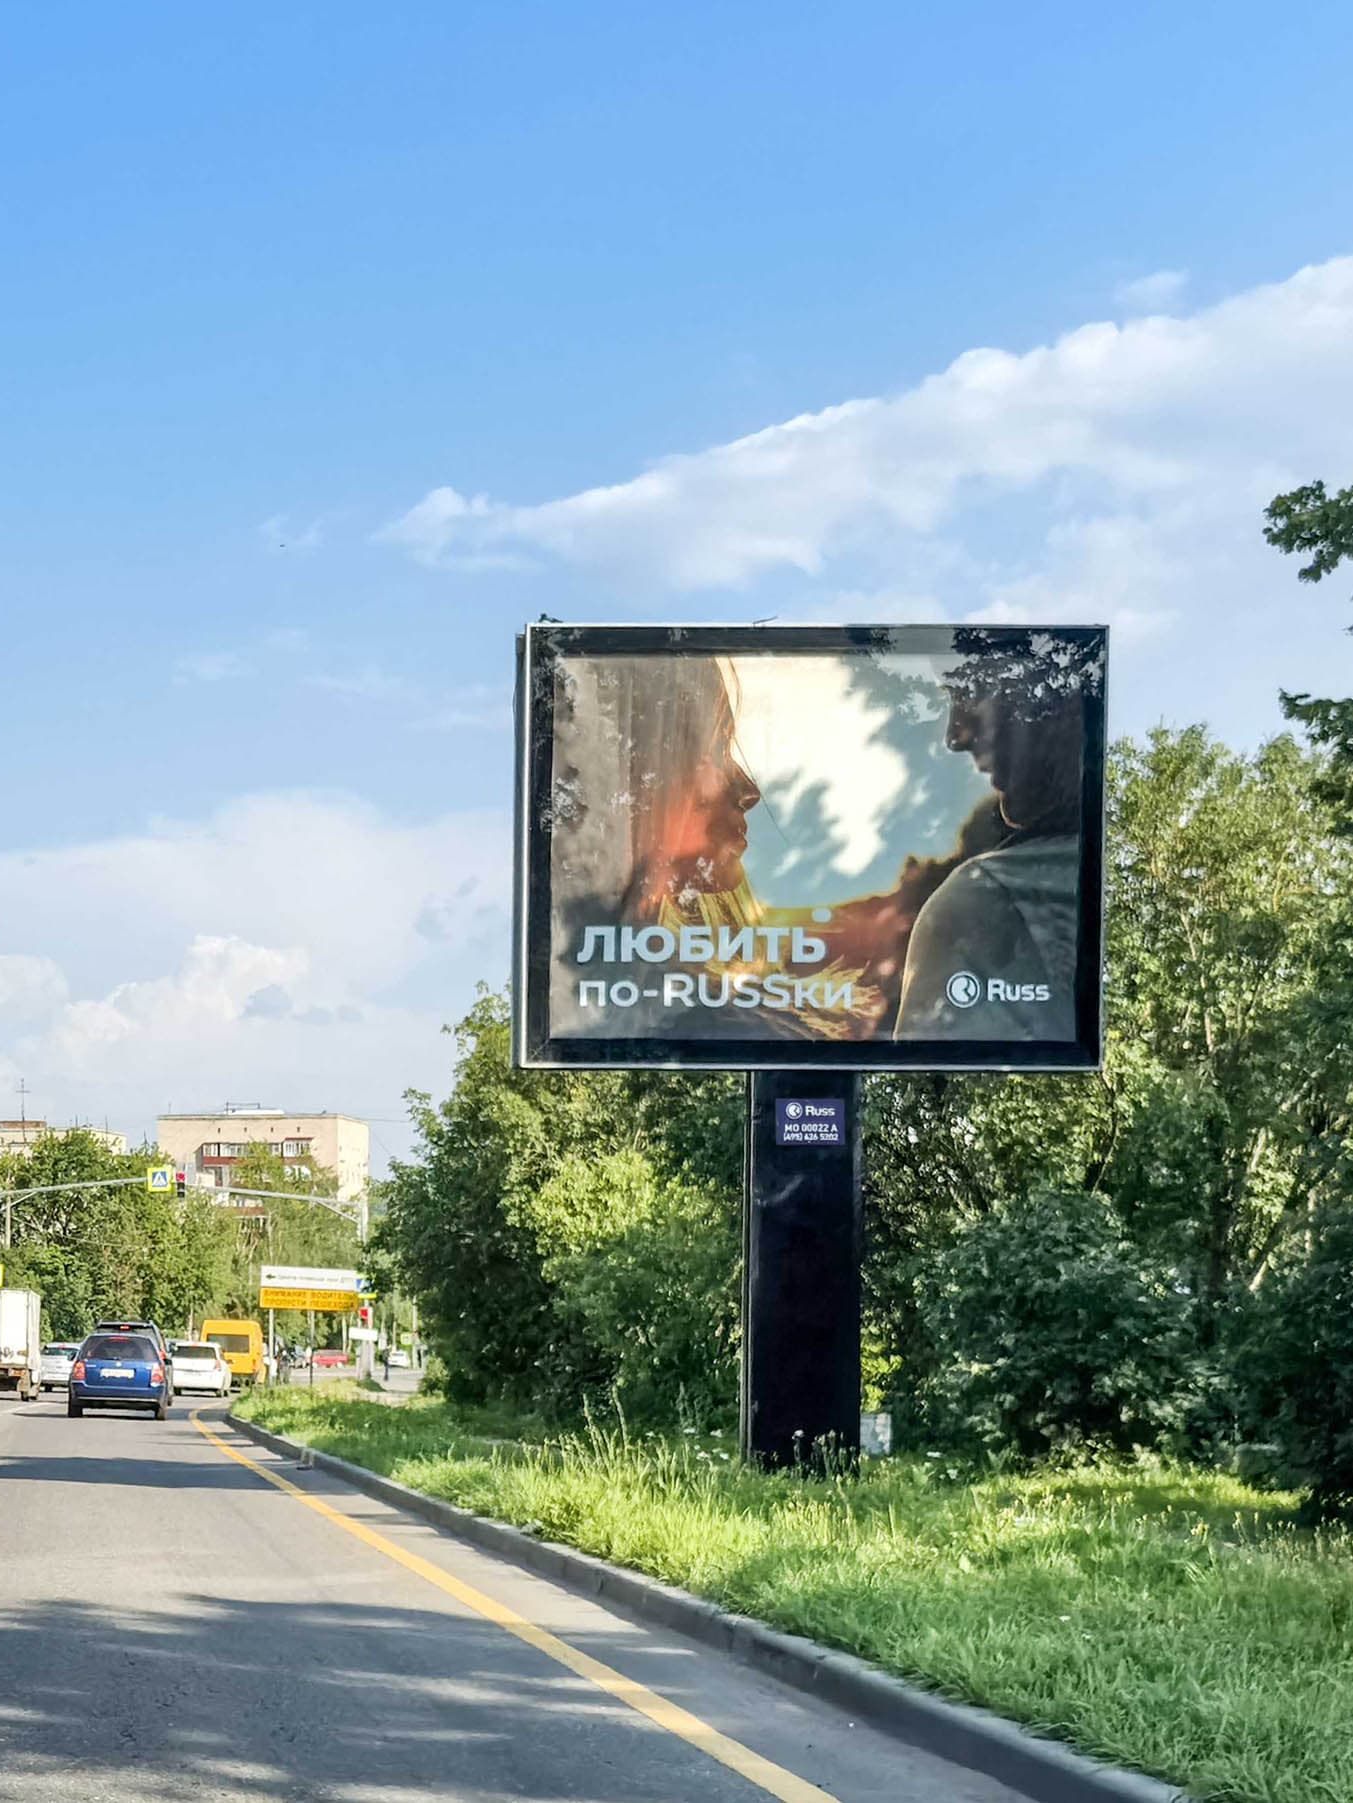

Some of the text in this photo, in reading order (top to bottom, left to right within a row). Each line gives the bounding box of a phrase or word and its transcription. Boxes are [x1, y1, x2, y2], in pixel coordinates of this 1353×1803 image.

[576, 925, 827, 964] ЛЮБИТЬ
[579, 972, 854, 1009] по-RUSSки
[987, 978, 1050, 1002] Russ
[805, 1105, 836, 1117] Russ
[801, 1123, 829, 1133] 00022
